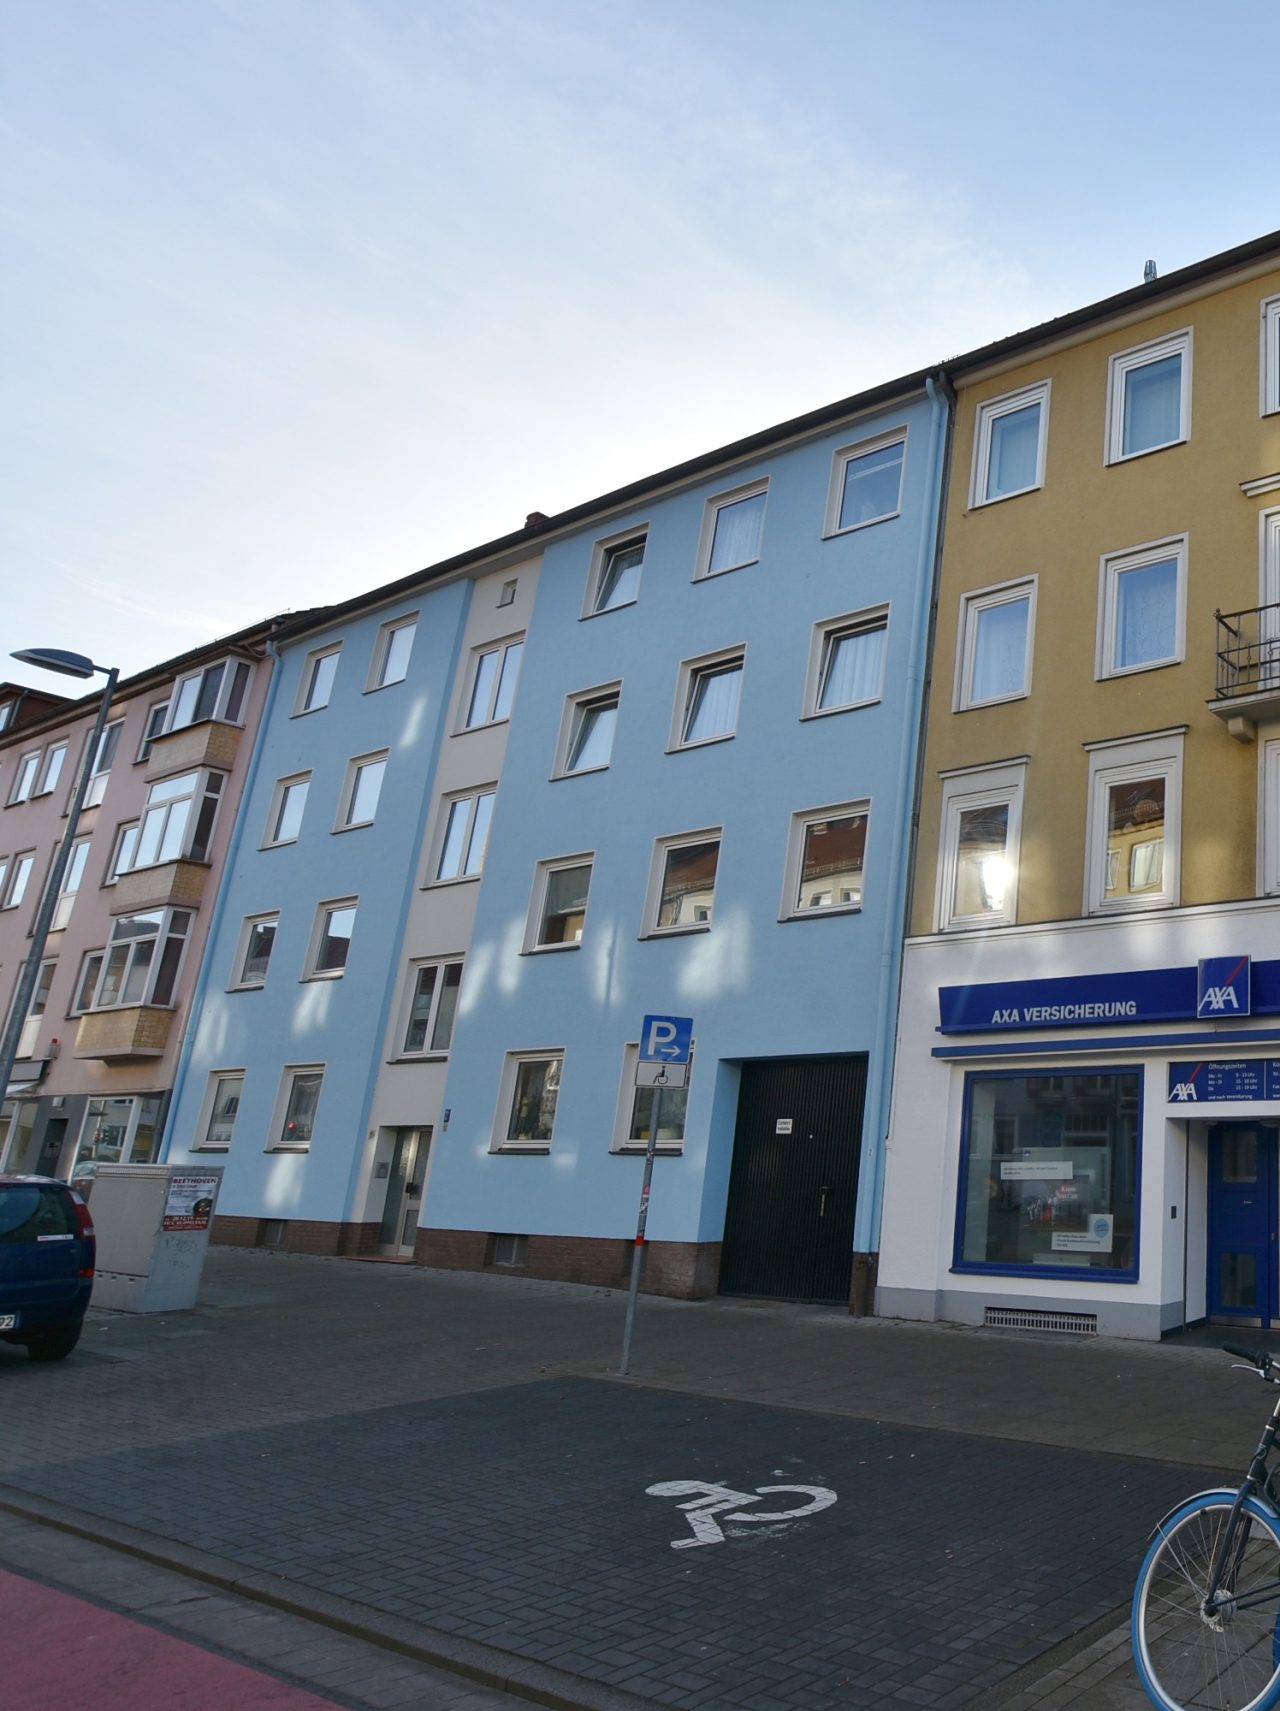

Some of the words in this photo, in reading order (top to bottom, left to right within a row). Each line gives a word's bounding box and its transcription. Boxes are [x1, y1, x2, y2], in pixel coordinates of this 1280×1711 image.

[1198, 986, 1239, 1011] AXA
[992, 1009, 1020, 1024] AXA
[1023, 1001, 1137, 1021] VERSICHERUNG
[647, 1021, 677, 1056] P
[1168, 1083, 1197, 1100] AXA
